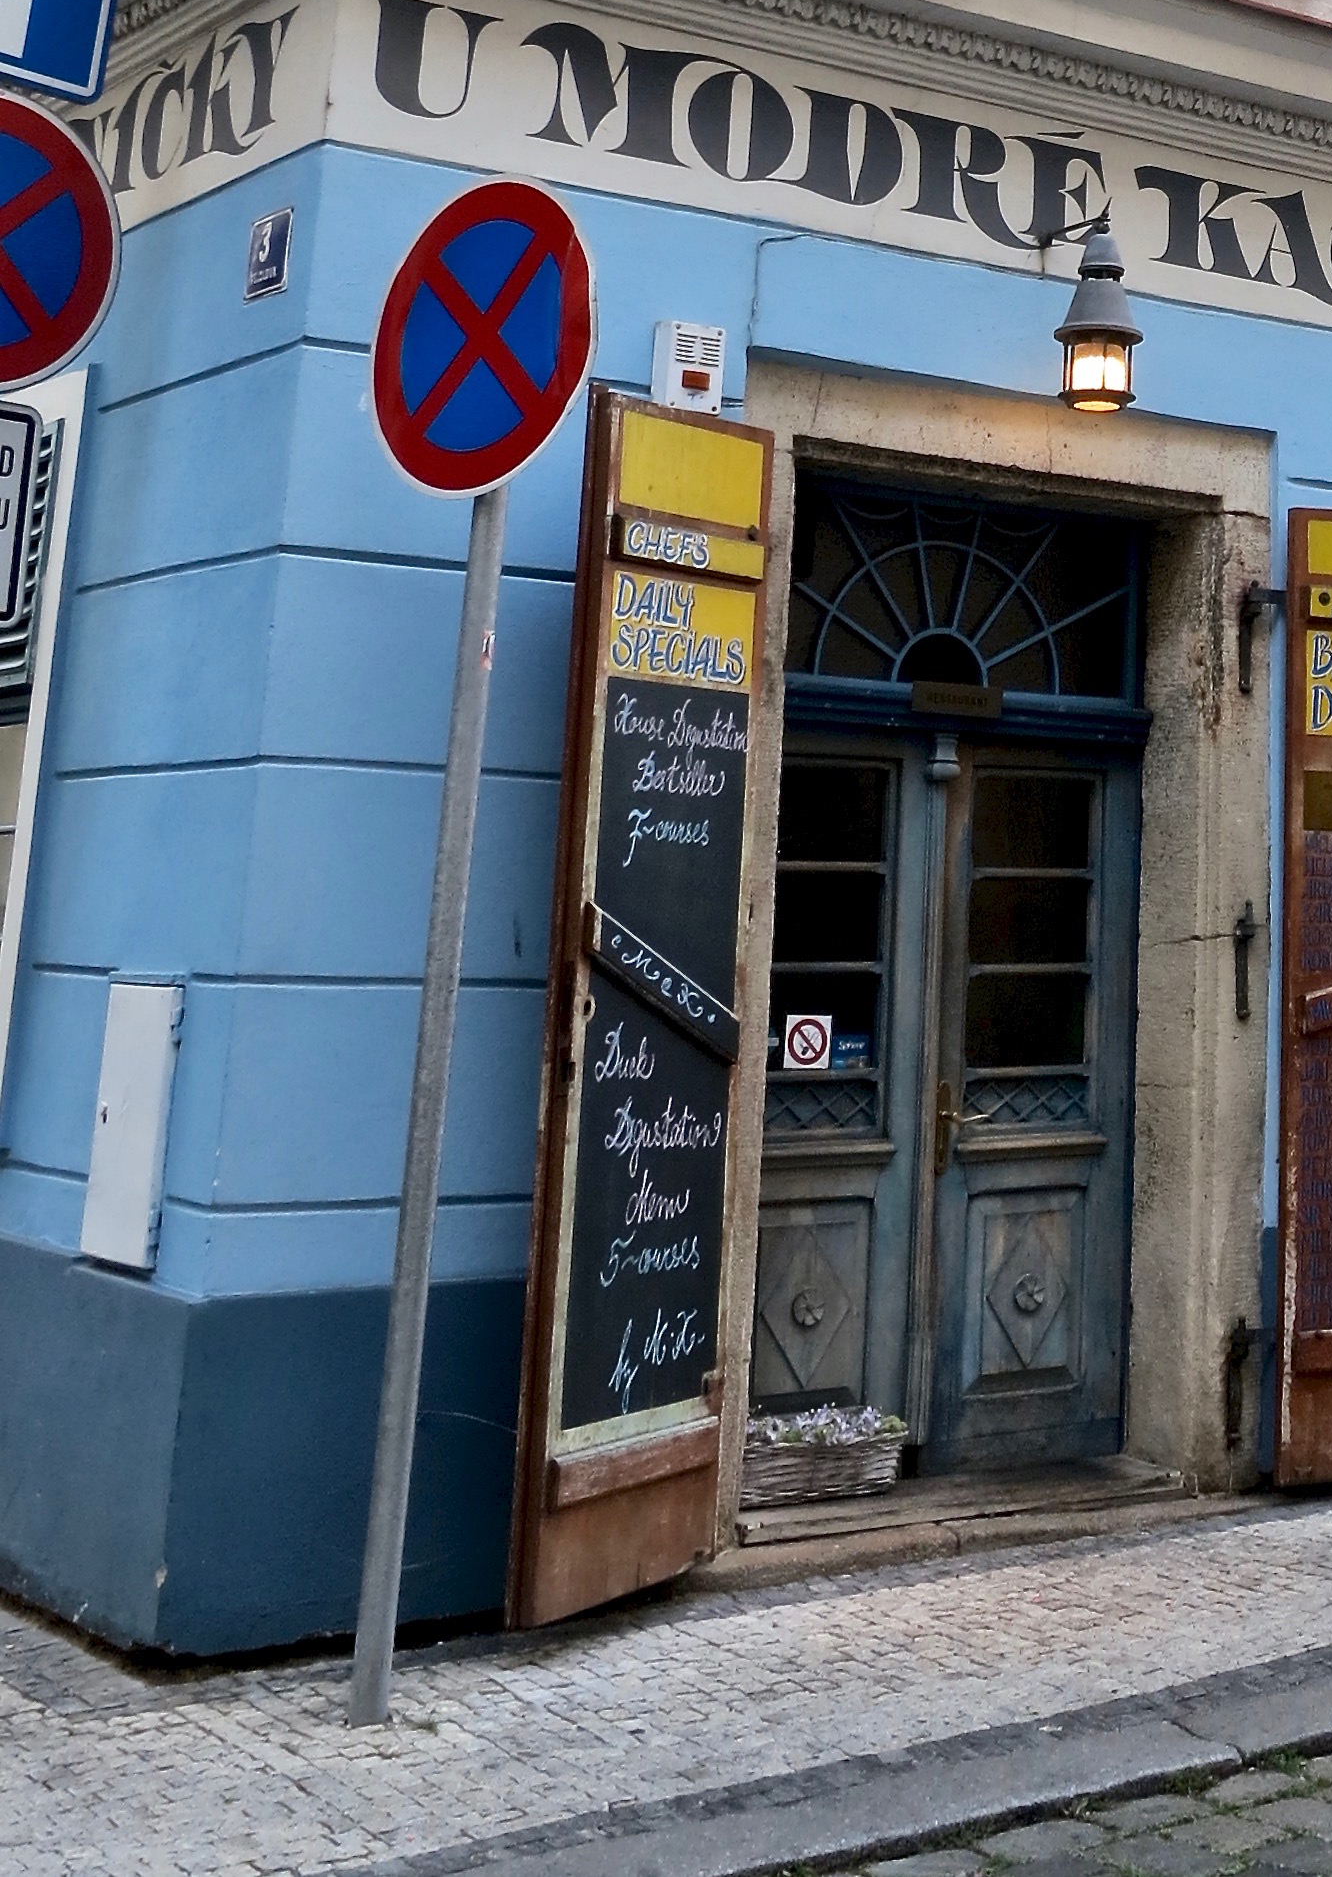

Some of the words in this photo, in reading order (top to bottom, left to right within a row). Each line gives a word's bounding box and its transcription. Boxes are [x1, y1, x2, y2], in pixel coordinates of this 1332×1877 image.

[519, 22, 1108, 250] MODRÉ
[258, 222, 273, 263] 3
[614, 573, 694, 630] DAILY
[611, 624, 745, 684] SPECIALS
[594, 1021, 655, 1082] Duck
